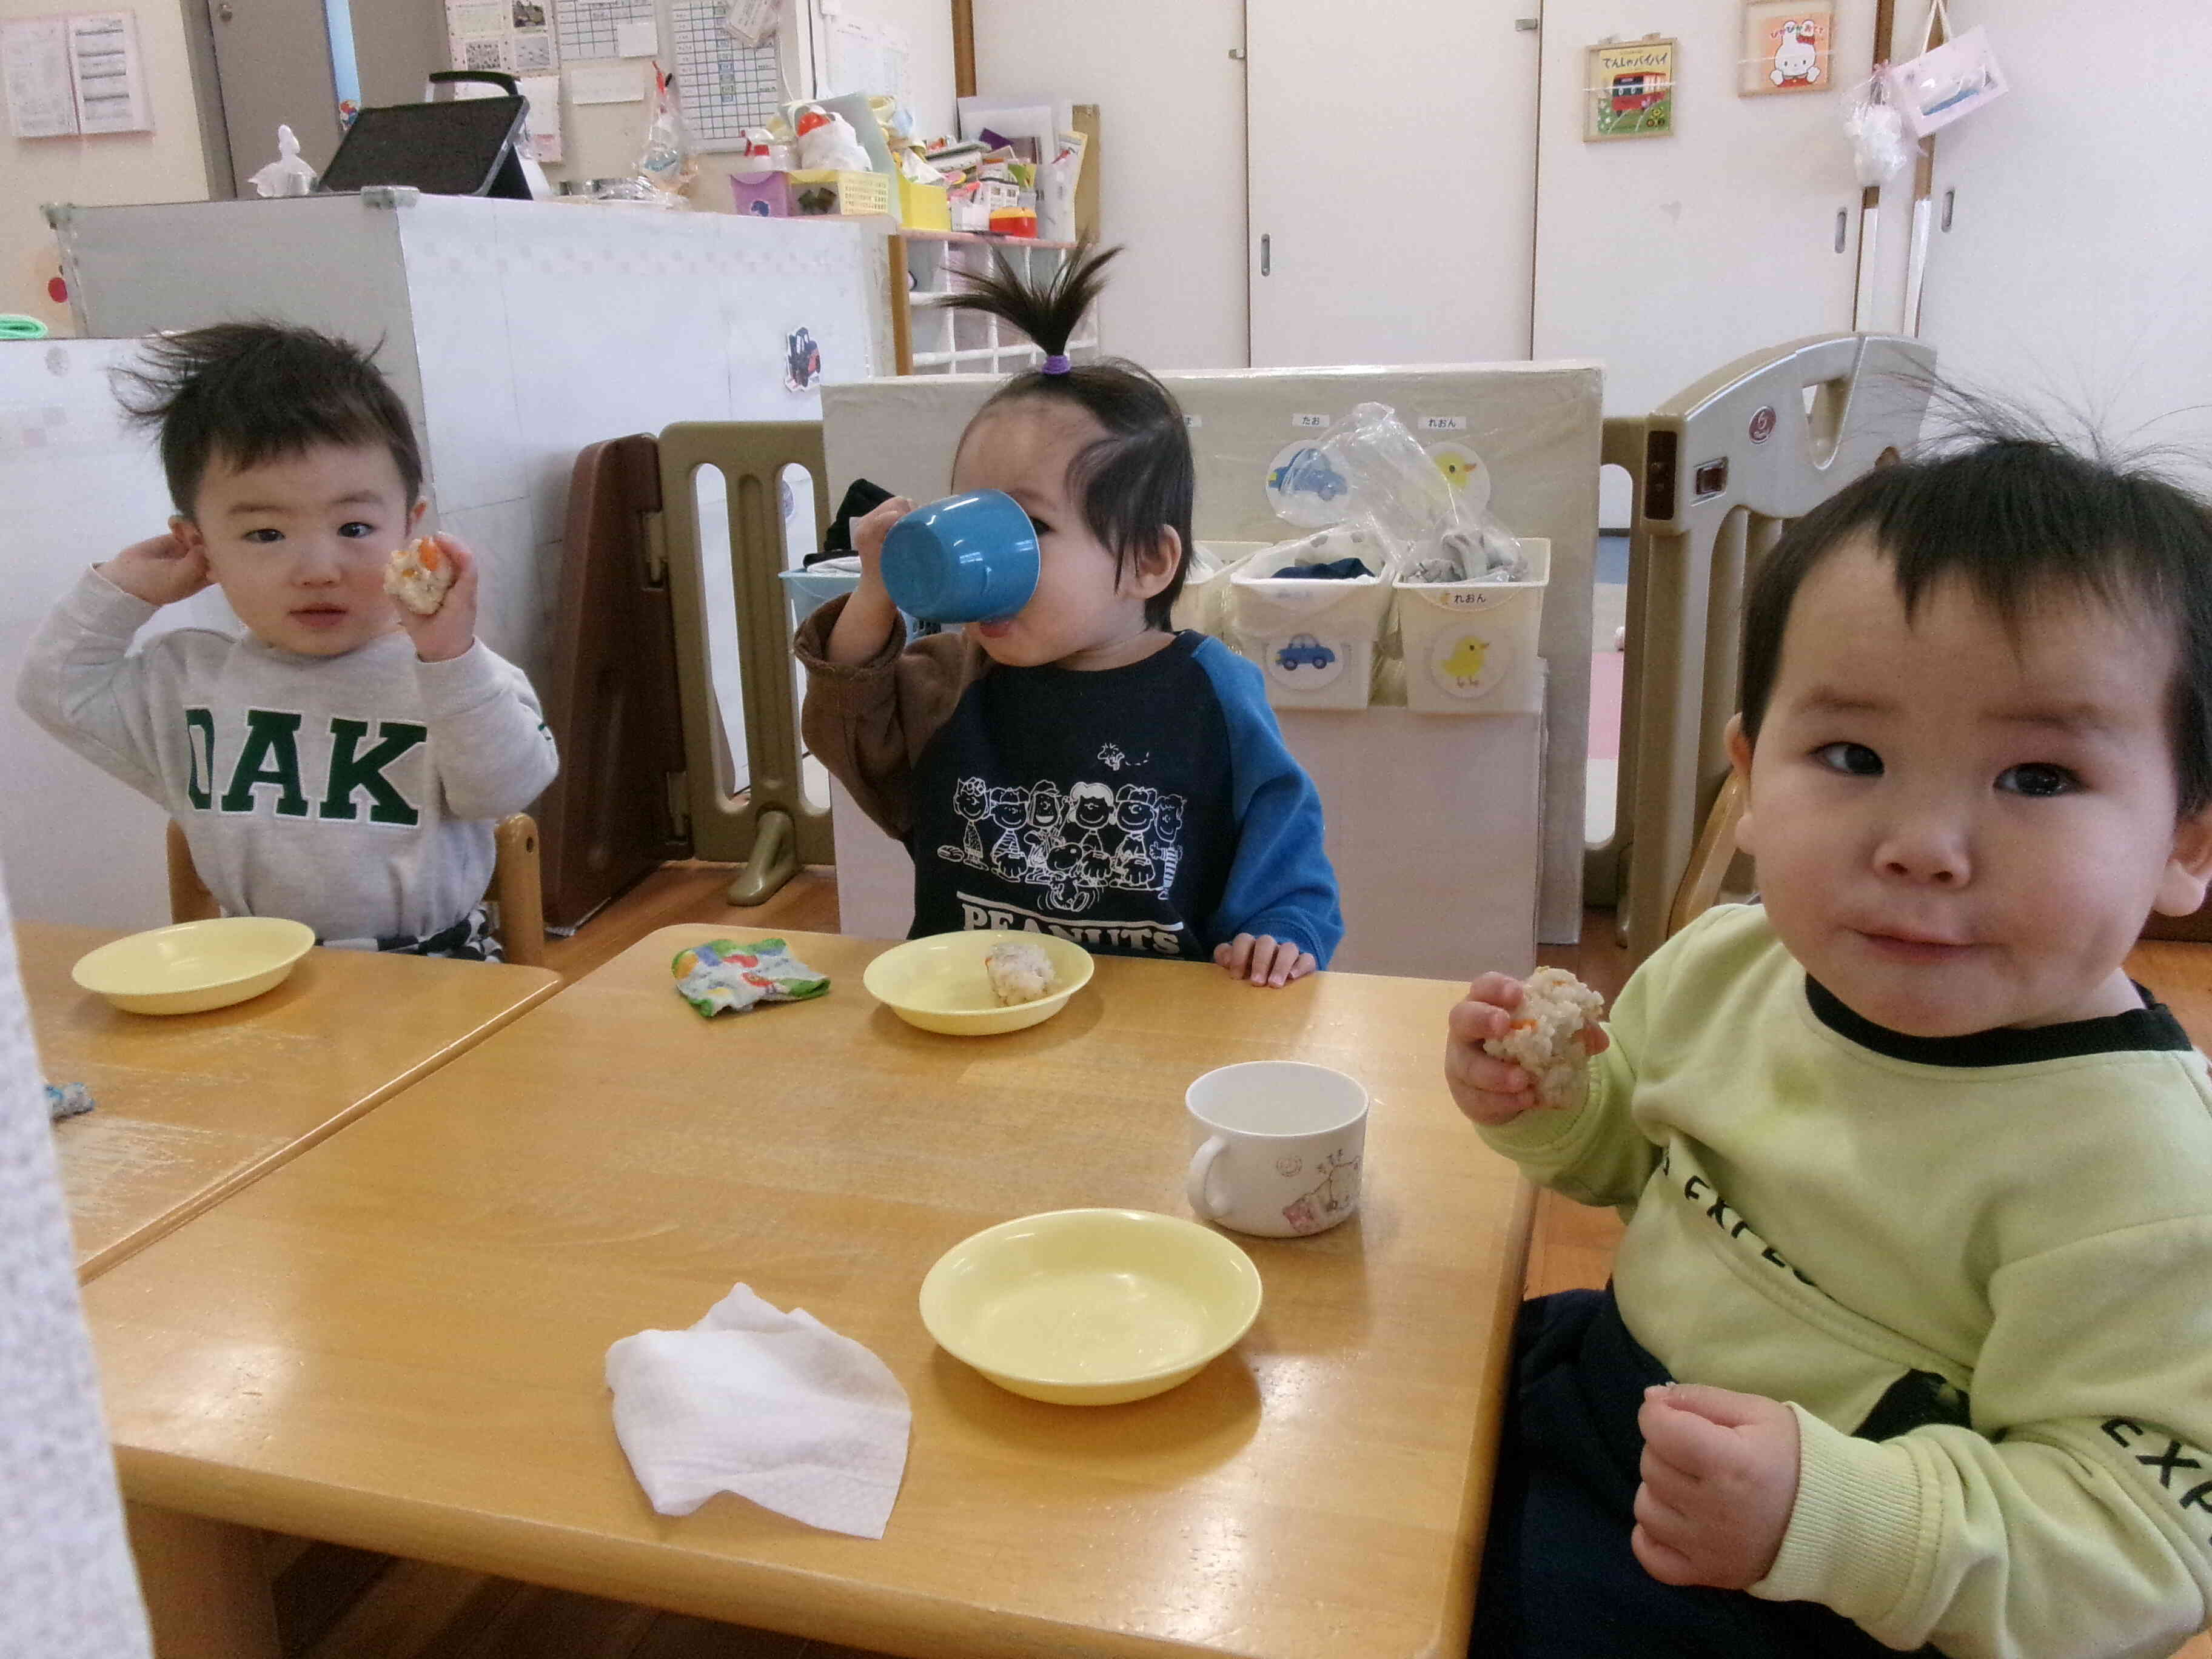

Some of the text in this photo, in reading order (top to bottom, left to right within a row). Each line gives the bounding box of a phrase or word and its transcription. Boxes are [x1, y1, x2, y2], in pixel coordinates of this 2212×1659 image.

[1302, 415, 1320, 425] たお
[1428, 418, 1456, 427] れおん
[1454, 594, 1486, 603] れおん
